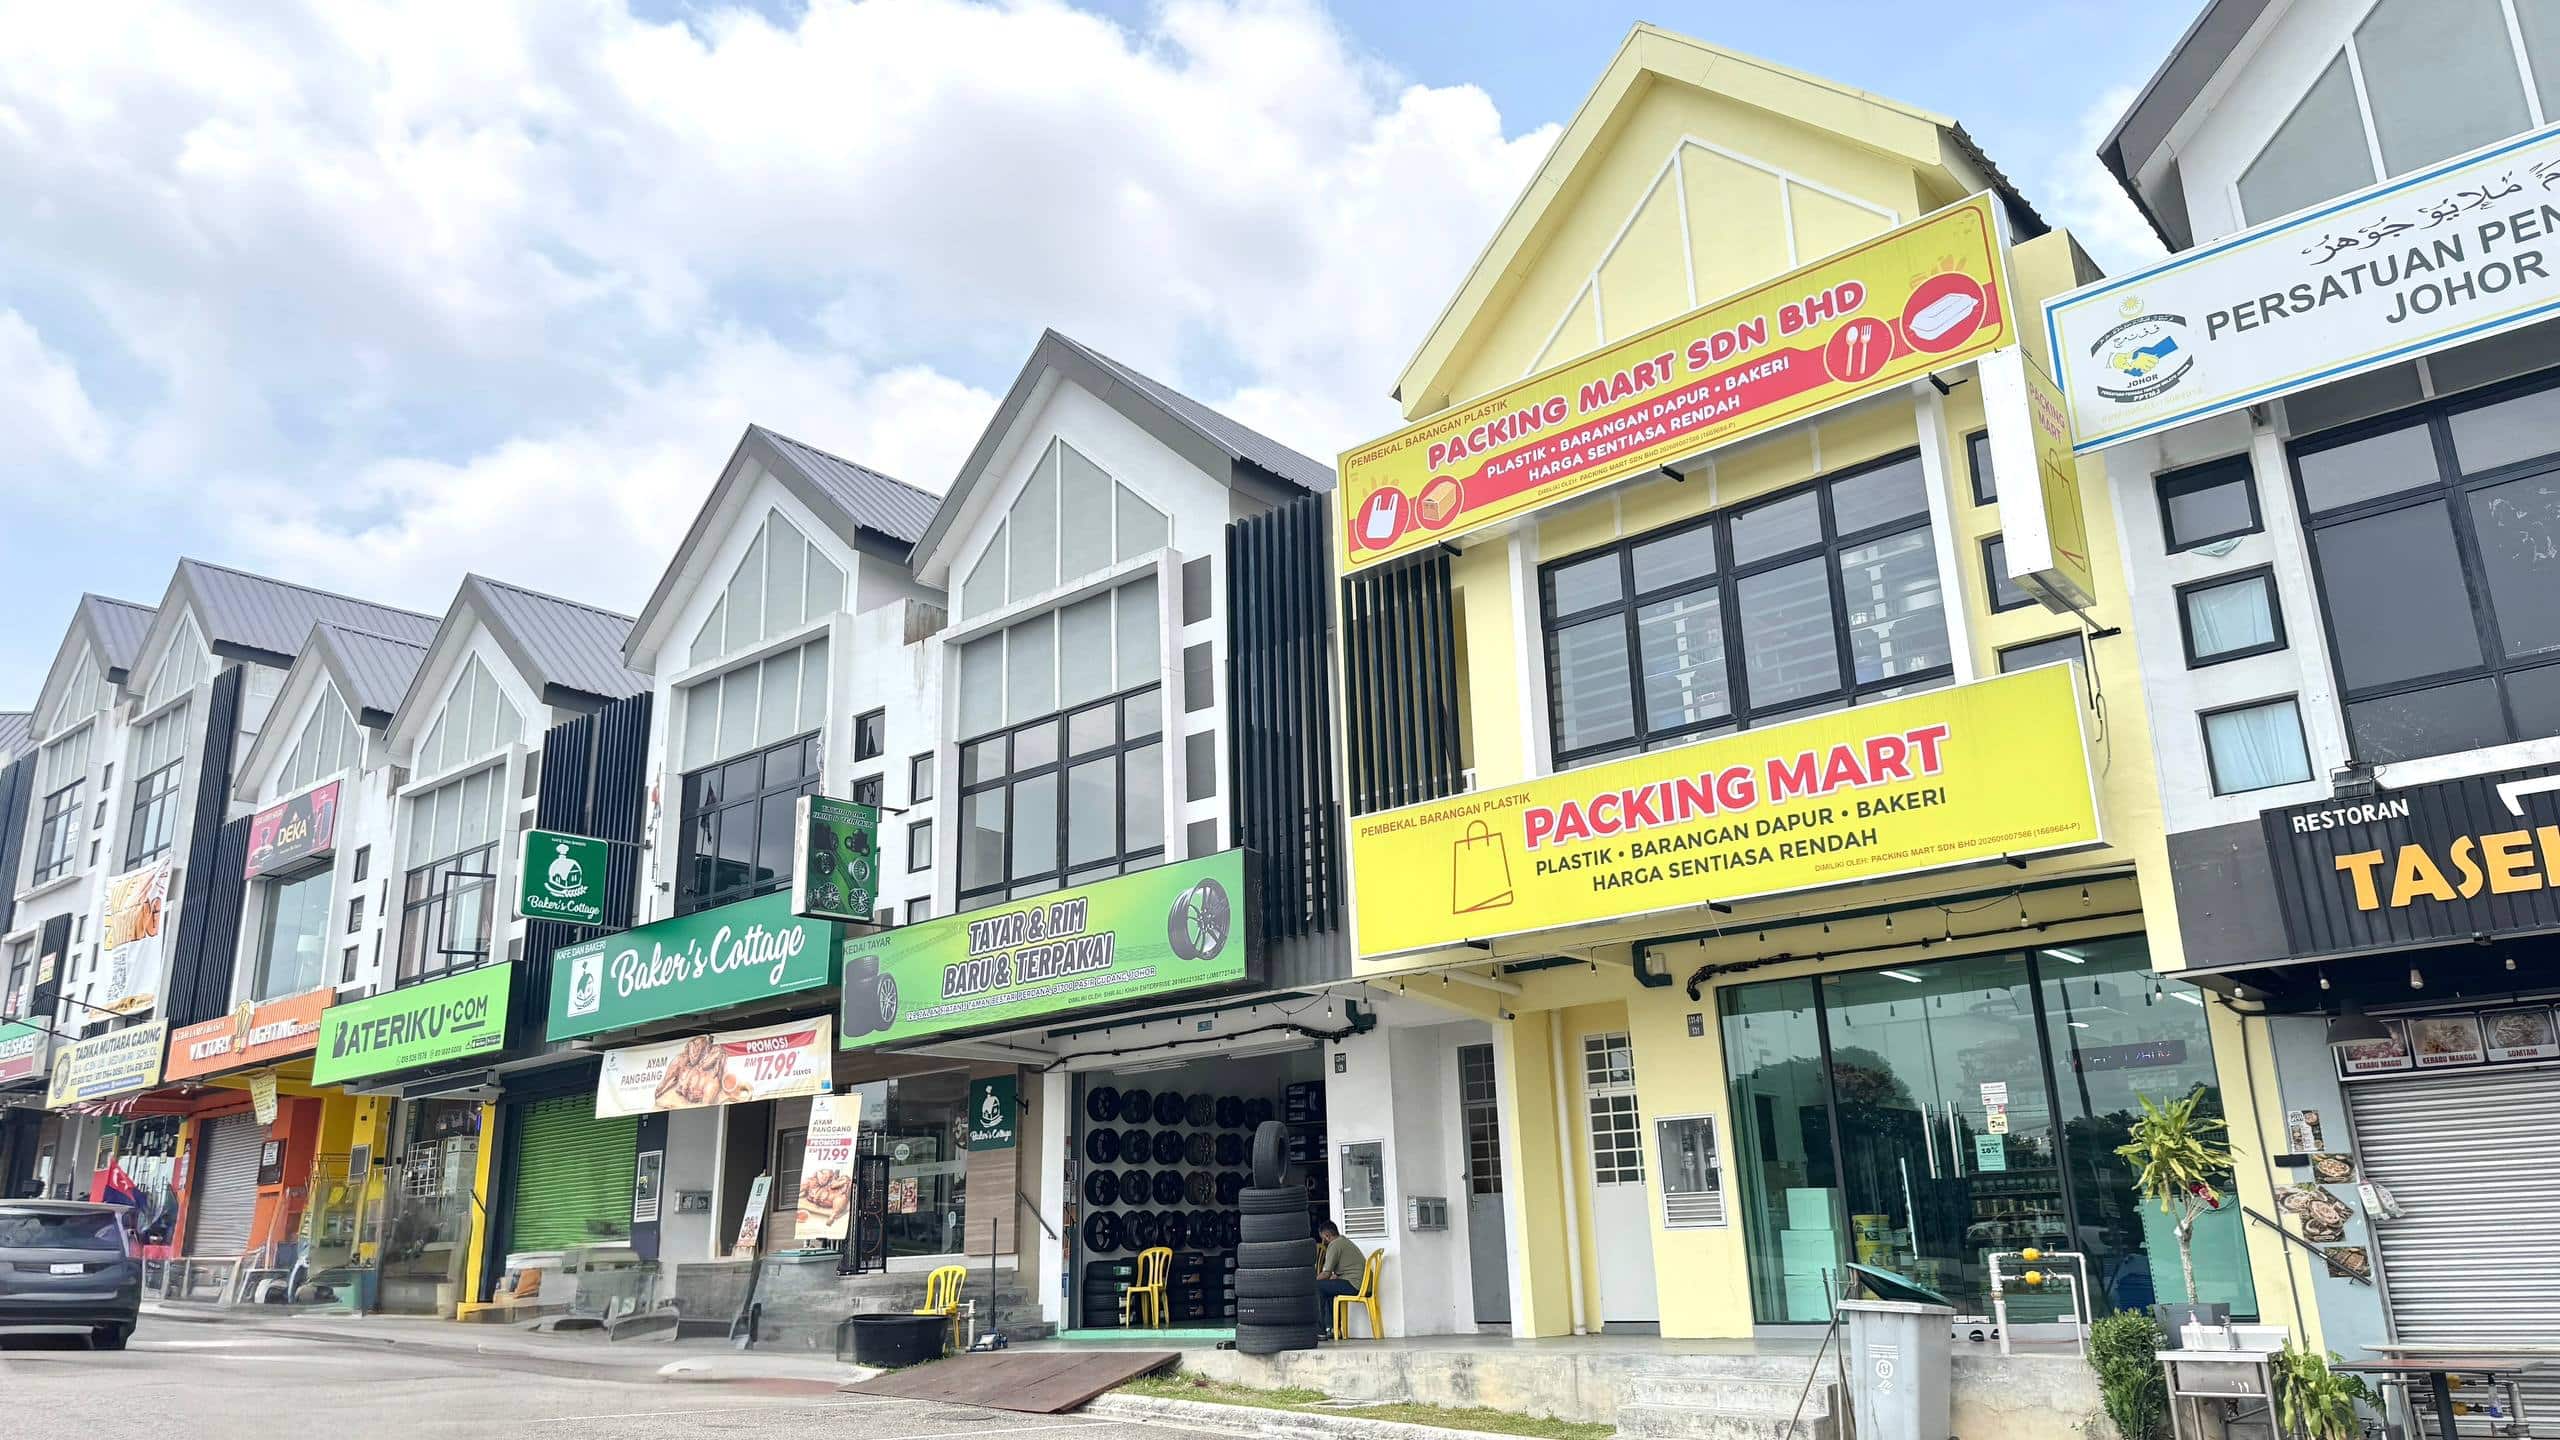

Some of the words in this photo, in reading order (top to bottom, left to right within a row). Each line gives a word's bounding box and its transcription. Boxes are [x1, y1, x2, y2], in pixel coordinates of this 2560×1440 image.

[2206, 233, 2466, 341] PERSATUAN
[2385, 249, 2551, 325] JOHOR
[1427, 393, 1569, 471] PACKING
[1579, 351, 1675, 415] MART
[1687, 316, 1768, 372] SDN
[1779, 280, 1866, 335] BHD
[2127, 374, 2159, 389] JOHOR
[1486, 447, 1547, 480] PLASTIK
[1559, 409, 1650, 452] BARANGAN
[1652, 387, 1710, 425] DAPUR
[1724, 355, 1790, 392] BAKERI
[2029, 382, 2066, 430] PACKING
[2037, 410, 2063, 443] MART
[1350, 442, 1404, 469] PEMBEKAL
[1405, 418, 1462, 448] BARANGAN
[1464, 399, 1508, 425] PLASTIK
[1528, 455, 1584, 482] HARGA
[1587, 425, 1666, 460] SENTIASA
[1670, 395, 1741, 431] RENDAH
[1525, 765, 1757, 851] PACKING
[1766, 724, 1951, 802] MART
[277, 819, 307, 847] DEKA
[1361, 818, 1417, 838] PEMBEKAL
[1420, 803, 1482, 826] BARANGAN
[1484, 792, 1531, 812] PLASTIK
[1536, 848, 1613, 877] PLASTIK
[1631, 822, 1750, 860] BARANGAN
[1755, 807, 1834, 837] DAPUR
[1856, 787, 1948, 819] BAKERI
[2292, 798, 2410, 834] RESTORAN
[1592, 865, 1665, 892] HARGA
[1668, 847, 1773, 880] SENTIASA
[1779, 828, 1878, 862] RENDAH
[1871, 850, 1909, 864] PACKING
[1910, 845, 1936, 857] MART
[1937, 841, 1956, 853] SDN
[1957, 838, 1977, 849] BHD
[527, 895, 567, 910] Baker's
[567, 900, 600, 919] Cottage
[968, 911, 1026, 955] TAYAR
[1026, 906, 1046, 942] &
[1047, 896, 1089, 938] RIM
[610, 938, 707, 998] Baker's
[710, 923, 805, 986] Cottage
[843, 942, 867, 955] KEDAI
[867, 936, 892, 951] TAYAR
[941, 954, 995, 999] BARU
[993, 952, 1012, 989] &
[1015, 930, 1116, 985] TERPAKAI
[646, 1056, 669, 1070] AYAM
[746, 1036, 789, 1054] PROMOSI
[620, 1070, 663, 1086] PANGGANG
[812, 1125, 852, 1133] PANGGANG
